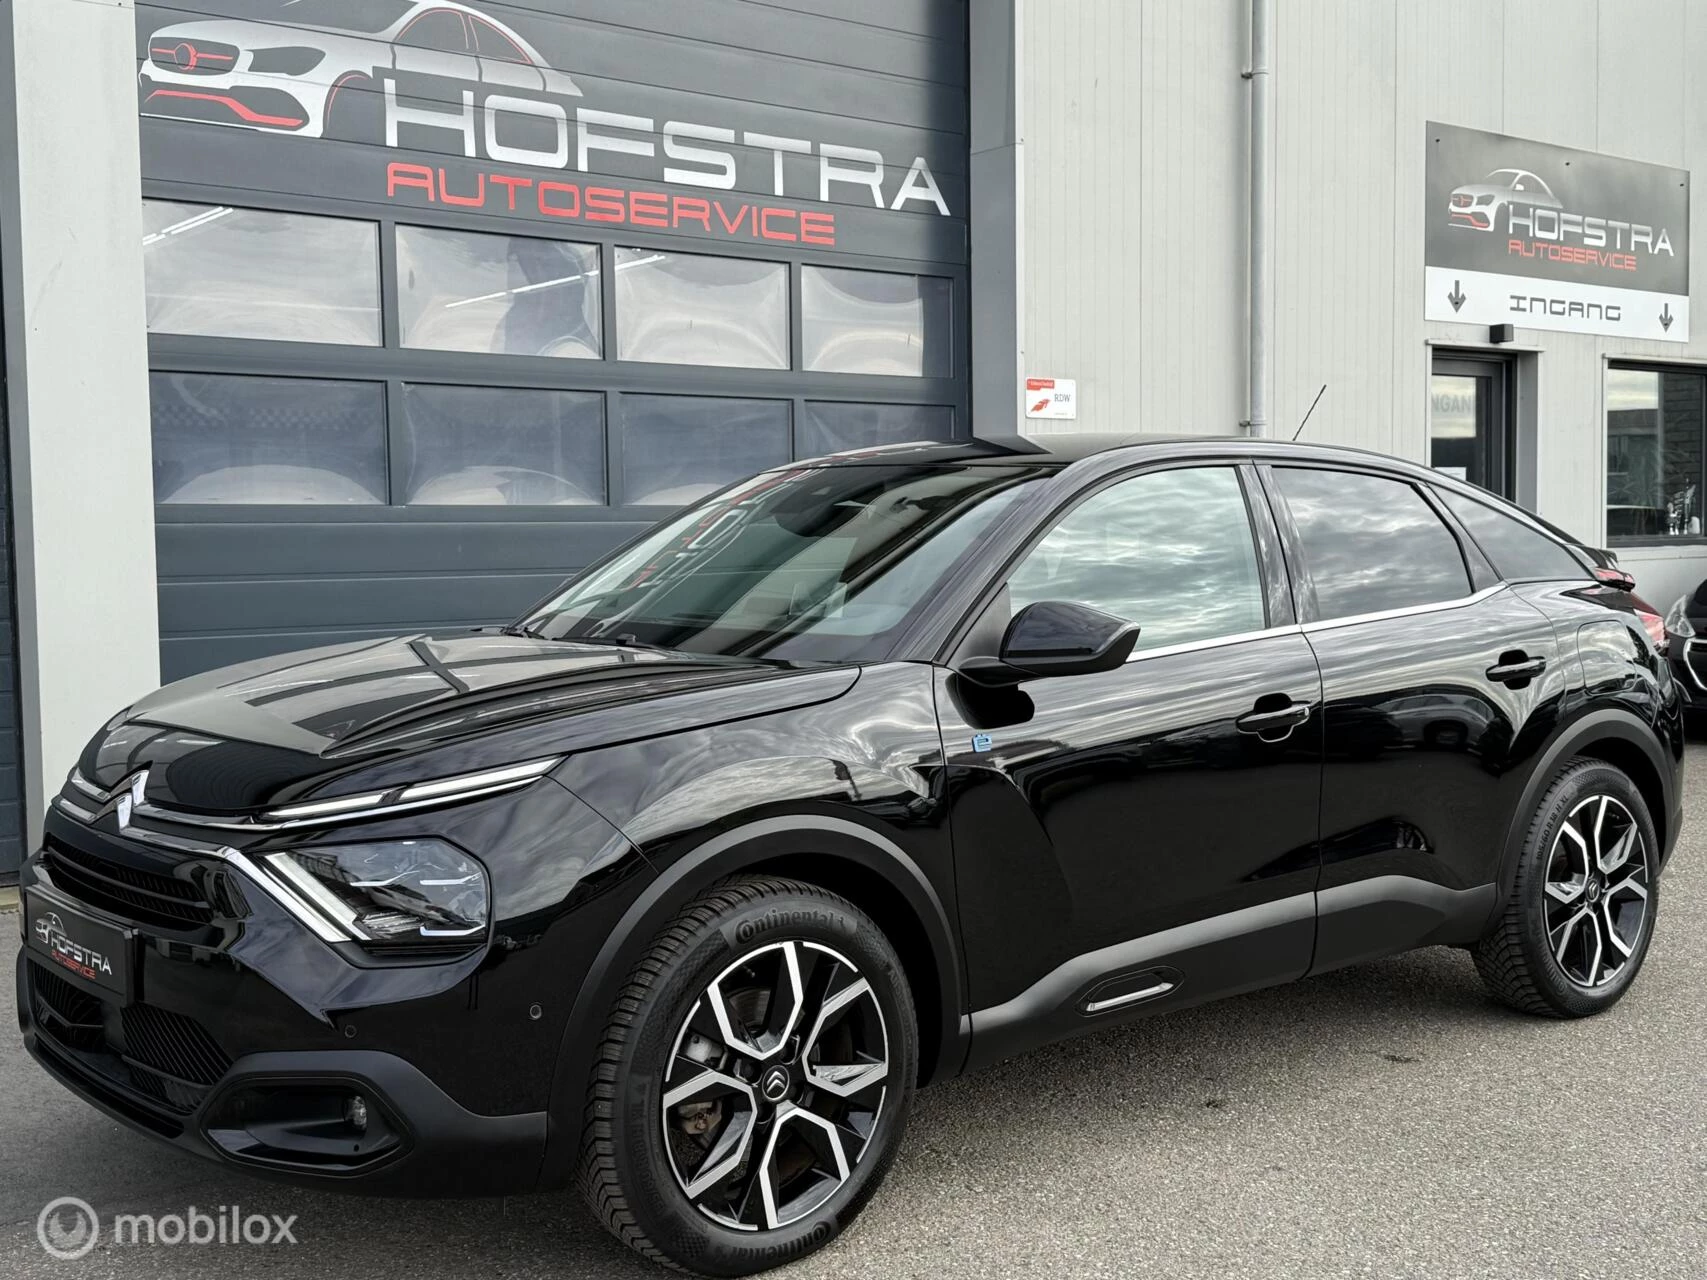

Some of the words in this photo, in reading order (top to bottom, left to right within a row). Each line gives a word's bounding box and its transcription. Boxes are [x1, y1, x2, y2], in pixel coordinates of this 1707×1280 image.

[385, 78, 950, 217] HOFSTRA
[387, 163, 835, 245] AUTOSERVICE
[1508, 204, 1674, 257] HOFSTRA
[1508, 240, 1637, 271] AUTOSERVICE
[1509, 294, 1621, 322] INGANG
[1054, 393, 1071, 403] RDW
[1431, 392, 1476, 413] NGAN
[735, 908, 834, 944] Continental
[51, 929, 112, 976] HOFSTRA
